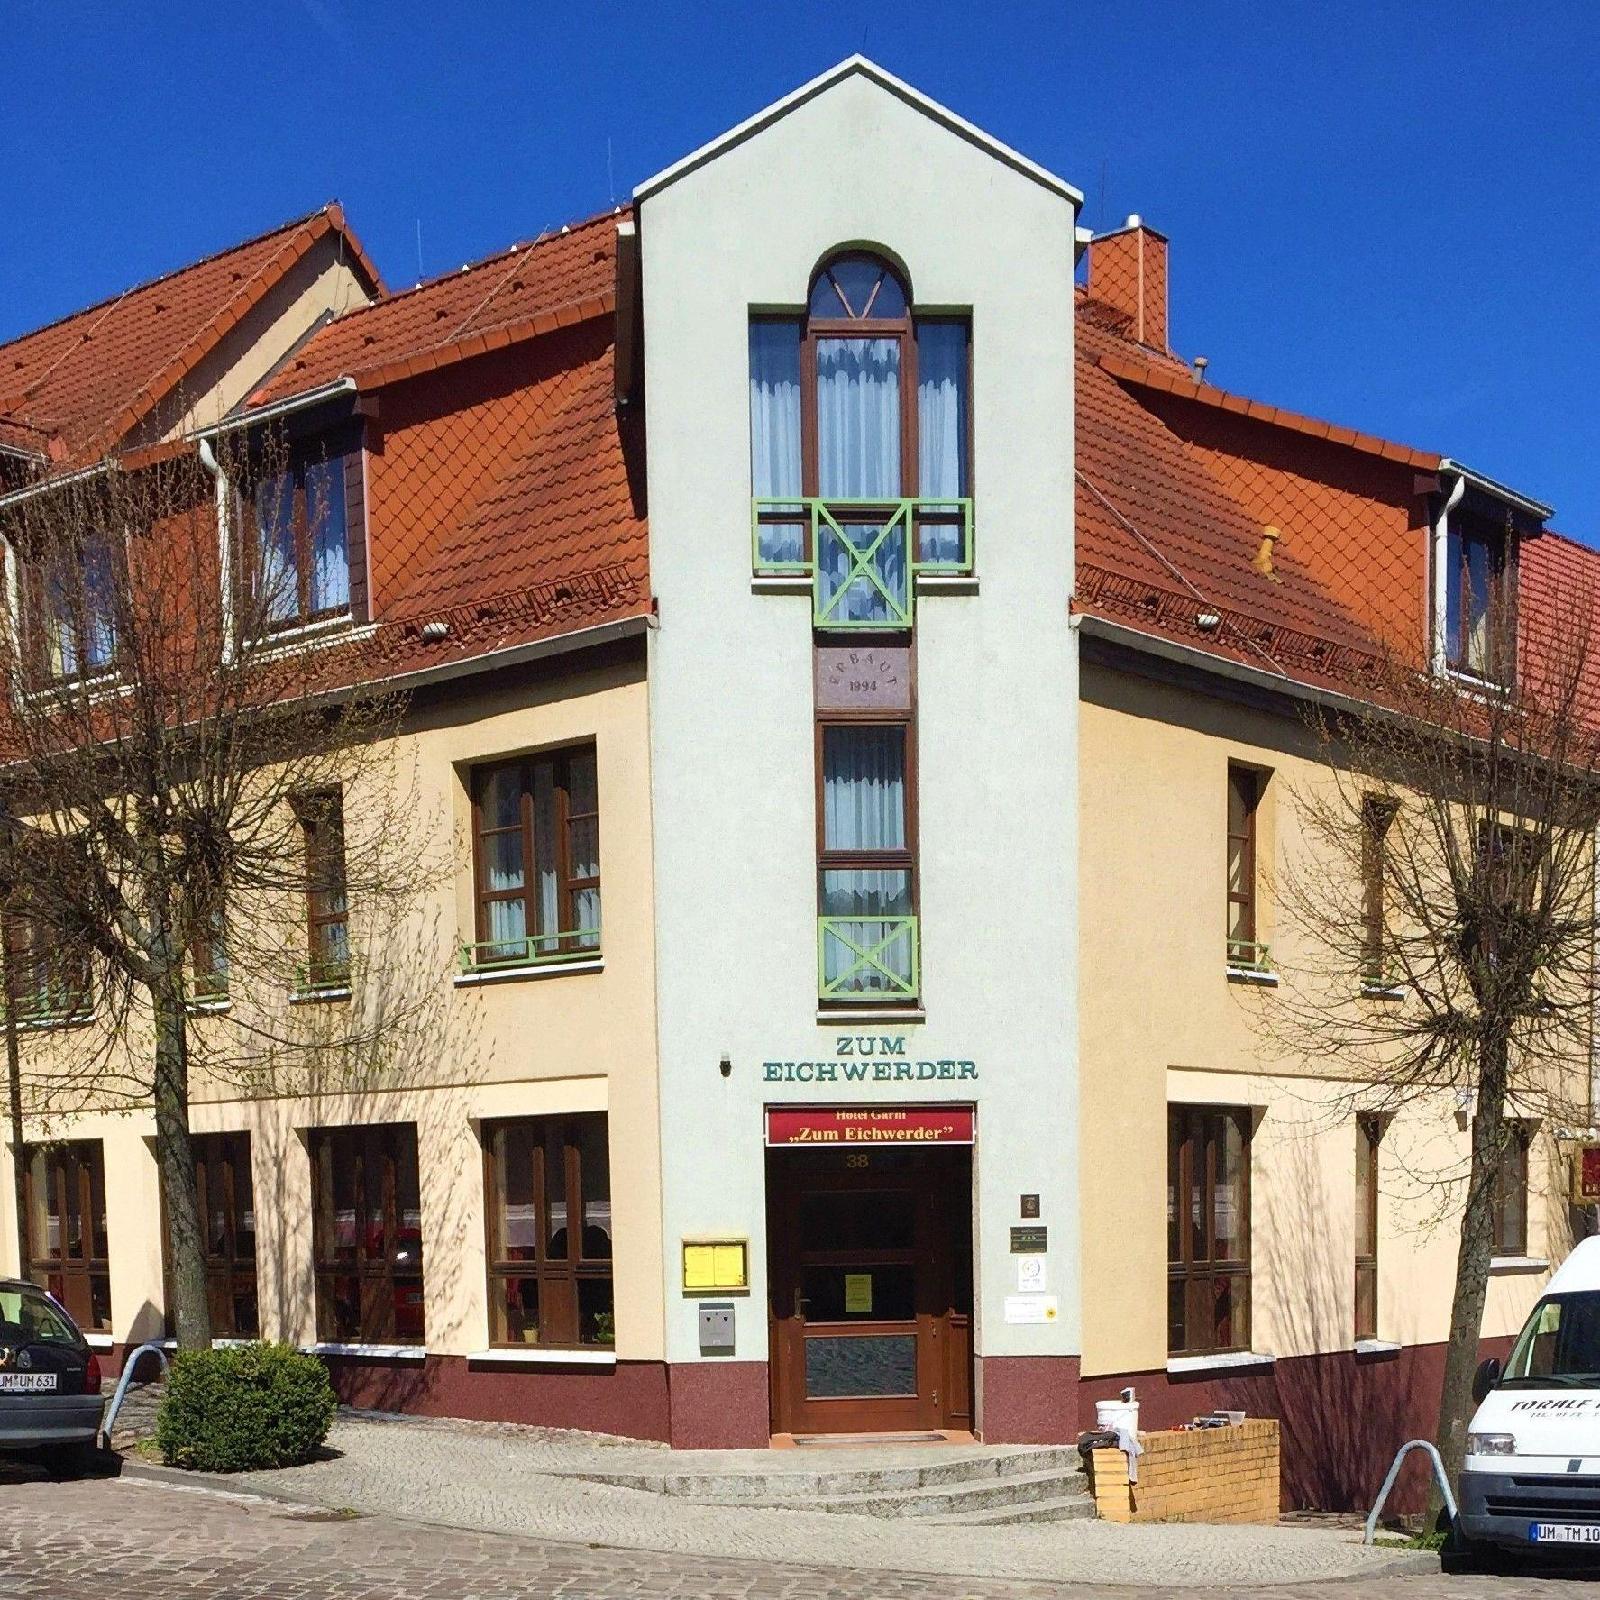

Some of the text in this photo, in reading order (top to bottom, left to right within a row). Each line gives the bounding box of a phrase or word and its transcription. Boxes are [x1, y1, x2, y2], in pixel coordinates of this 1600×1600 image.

[849, 681, 877, 692] 1994
[836, 1036, 905, 1056] ZUM
[763, 1060, 978, 1082] EICHWERDER
[836, 1110, 907, 1121] Hotel Garni
[846, 1154, 869, 1168] 38
[36, 1375, 55, 1387] 631
[1511, 1399, 1593, 1411] TORALF
[1538, 1526, 1555, 1539] UM
[1564, 1527, 1581, 1541] TM
